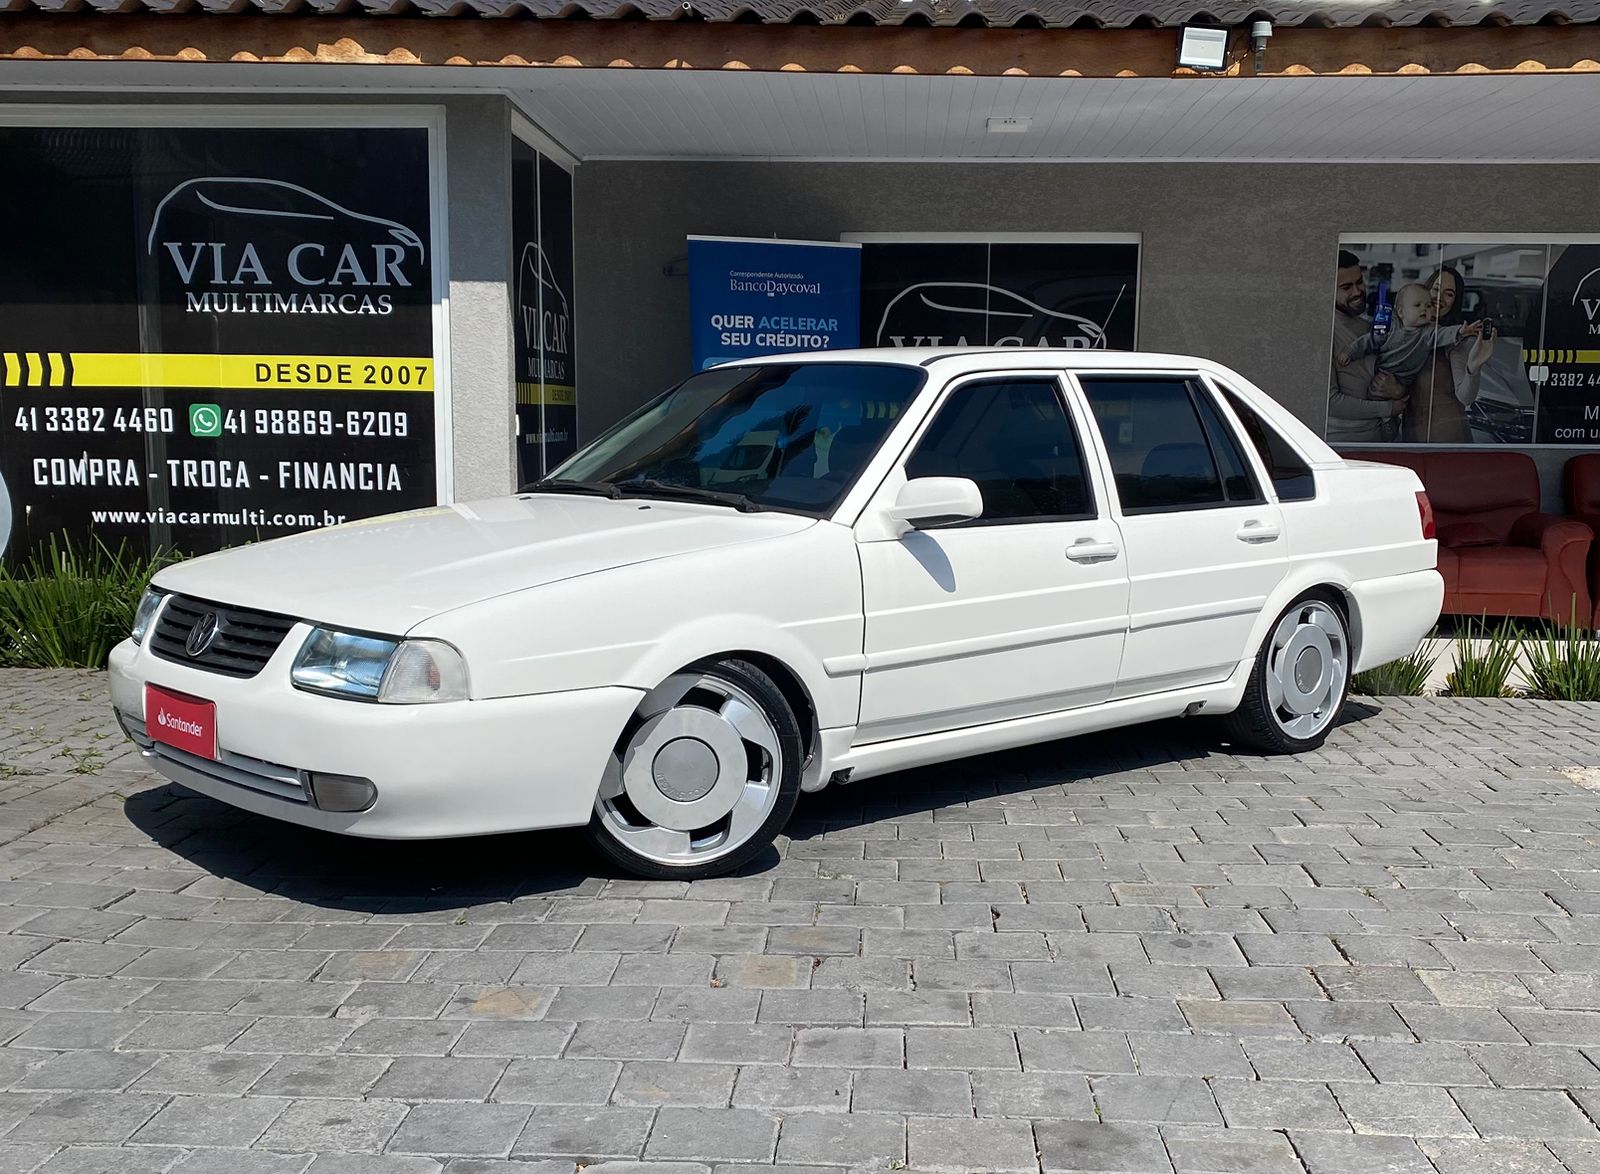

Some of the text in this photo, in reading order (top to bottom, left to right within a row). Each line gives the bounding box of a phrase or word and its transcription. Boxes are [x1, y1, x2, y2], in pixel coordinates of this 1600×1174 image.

[163, 241, 412, 286] VIA CAR
[729, 270, 804, 280] Correspondente Autorizado
[730, 279, 821, 296] BancoDaycoval
[185, 291, 393, 315] MULTIMARCAS
[522, 304, 568, 355] VI CAR
[710, 314, 838, 332] QUER ACELERAR
[721, 331, 830, 348] SEU CRÉDITO?
[256, 363, 428, 385] DESDE 2007
[1550, 373, 1584, 387] 3382
[15, 407, 174, 433] 41 3382 4460
[224, 409, 408, 437] 41 98869-6209
[1555, 428, 1600, 438] com u
[33, 458, 140, 486] COMPRA
[167, 459, 250, 488] TROCA
[278, 461, 402, 491] FINANCIA
[91, 507, 346, 526] www.viacarmulti.com.br
[166, 712, 203, 737] Santander
